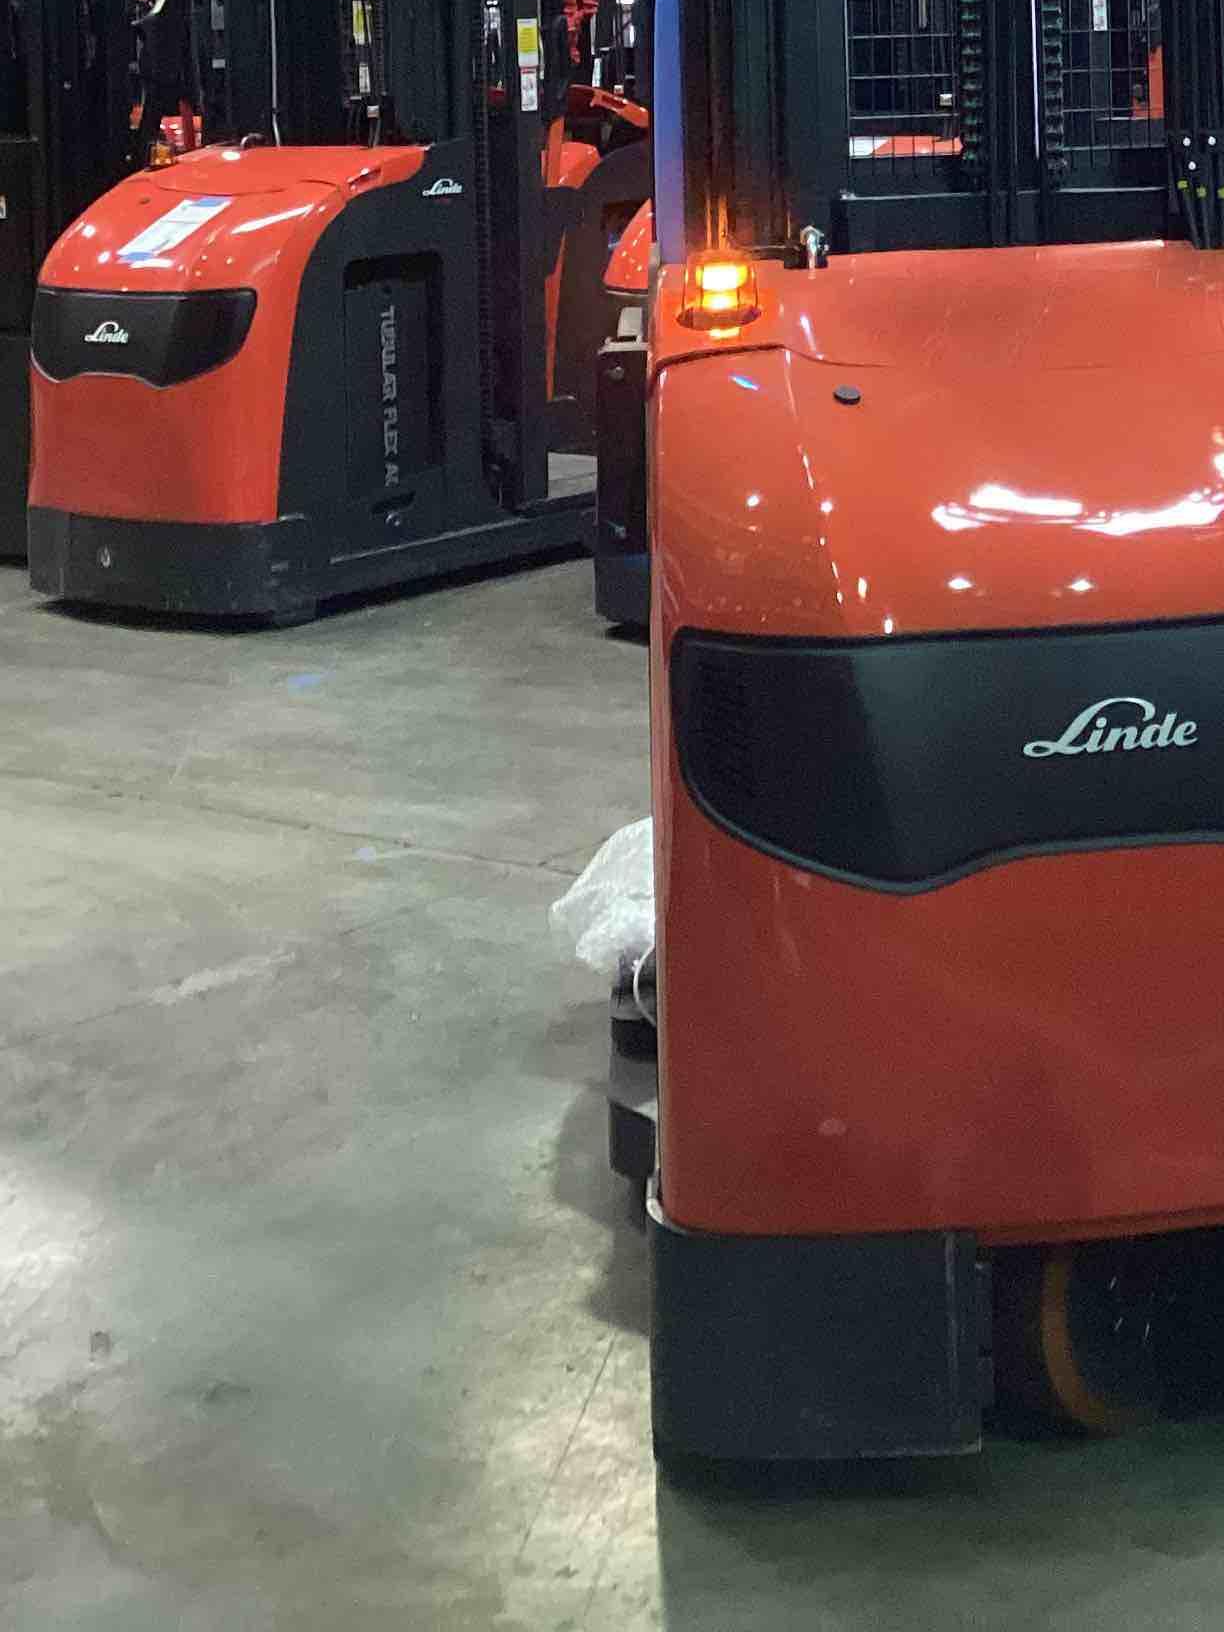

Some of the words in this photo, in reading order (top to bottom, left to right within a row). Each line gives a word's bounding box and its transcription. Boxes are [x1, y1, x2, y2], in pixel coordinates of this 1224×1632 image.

[423, 178, 463, 196] Linde
[84, 321, 129, 344] Linde
[1022, 697, 1199, 757] Linde
